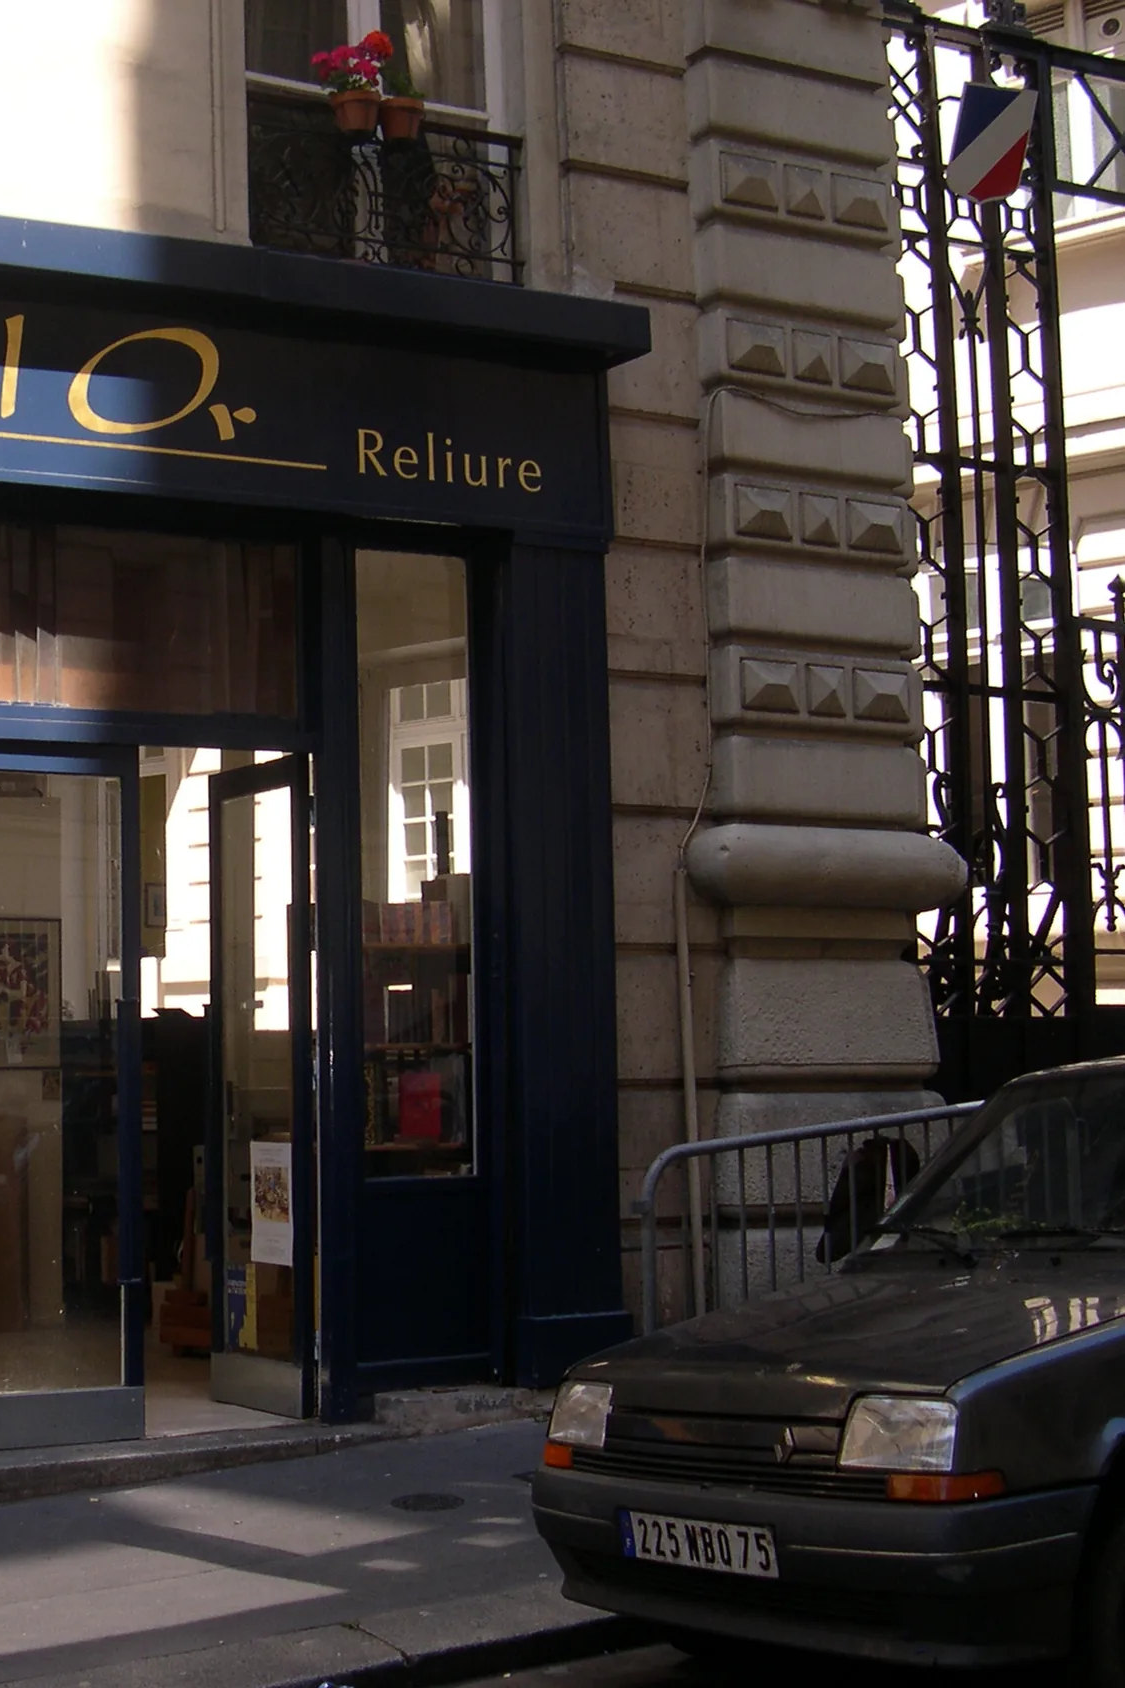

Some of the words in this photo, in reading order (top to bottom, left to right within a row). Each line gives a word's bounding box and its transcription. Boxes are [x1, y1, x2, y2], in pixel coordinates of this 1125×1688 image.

[67, 327, 257, 441] Or
[357, 428, 543, 493] Reliure
[637, 1518, 681, 1559] 225
[684, 1523, 733, 1568] NBQ
[736, 1530, 771, 1572] 75
